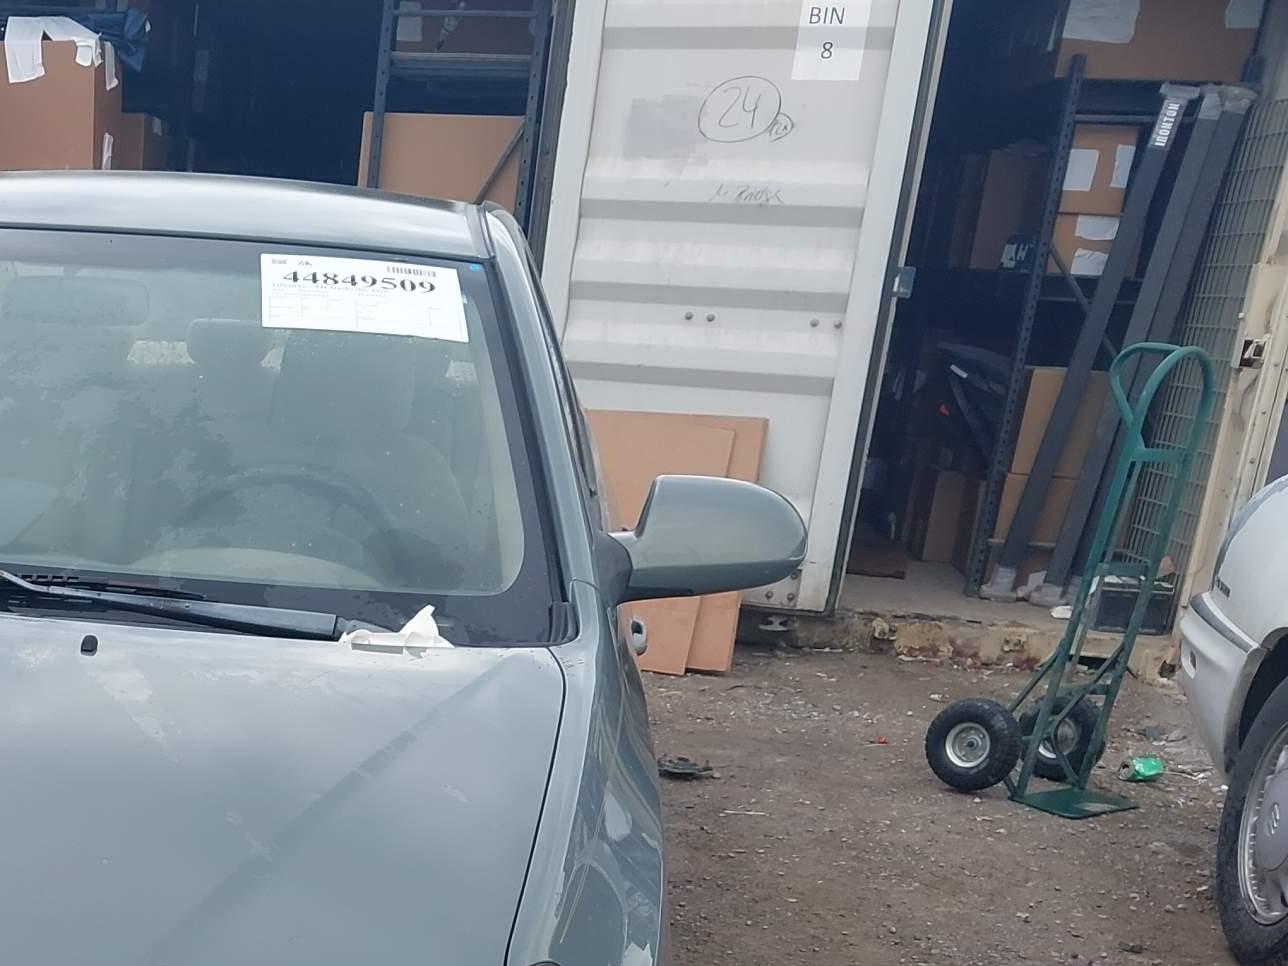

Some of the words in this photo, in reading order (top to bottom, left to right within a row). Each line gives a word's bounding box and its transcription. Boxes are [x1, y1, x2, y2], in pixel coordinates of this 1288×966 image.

[809, 6, 845, 25] BIN
[820, 41, 834, 59] 8
[1154, 103, 1181, 147] IRONTON
[283, 271, 436, 294] 44849509
